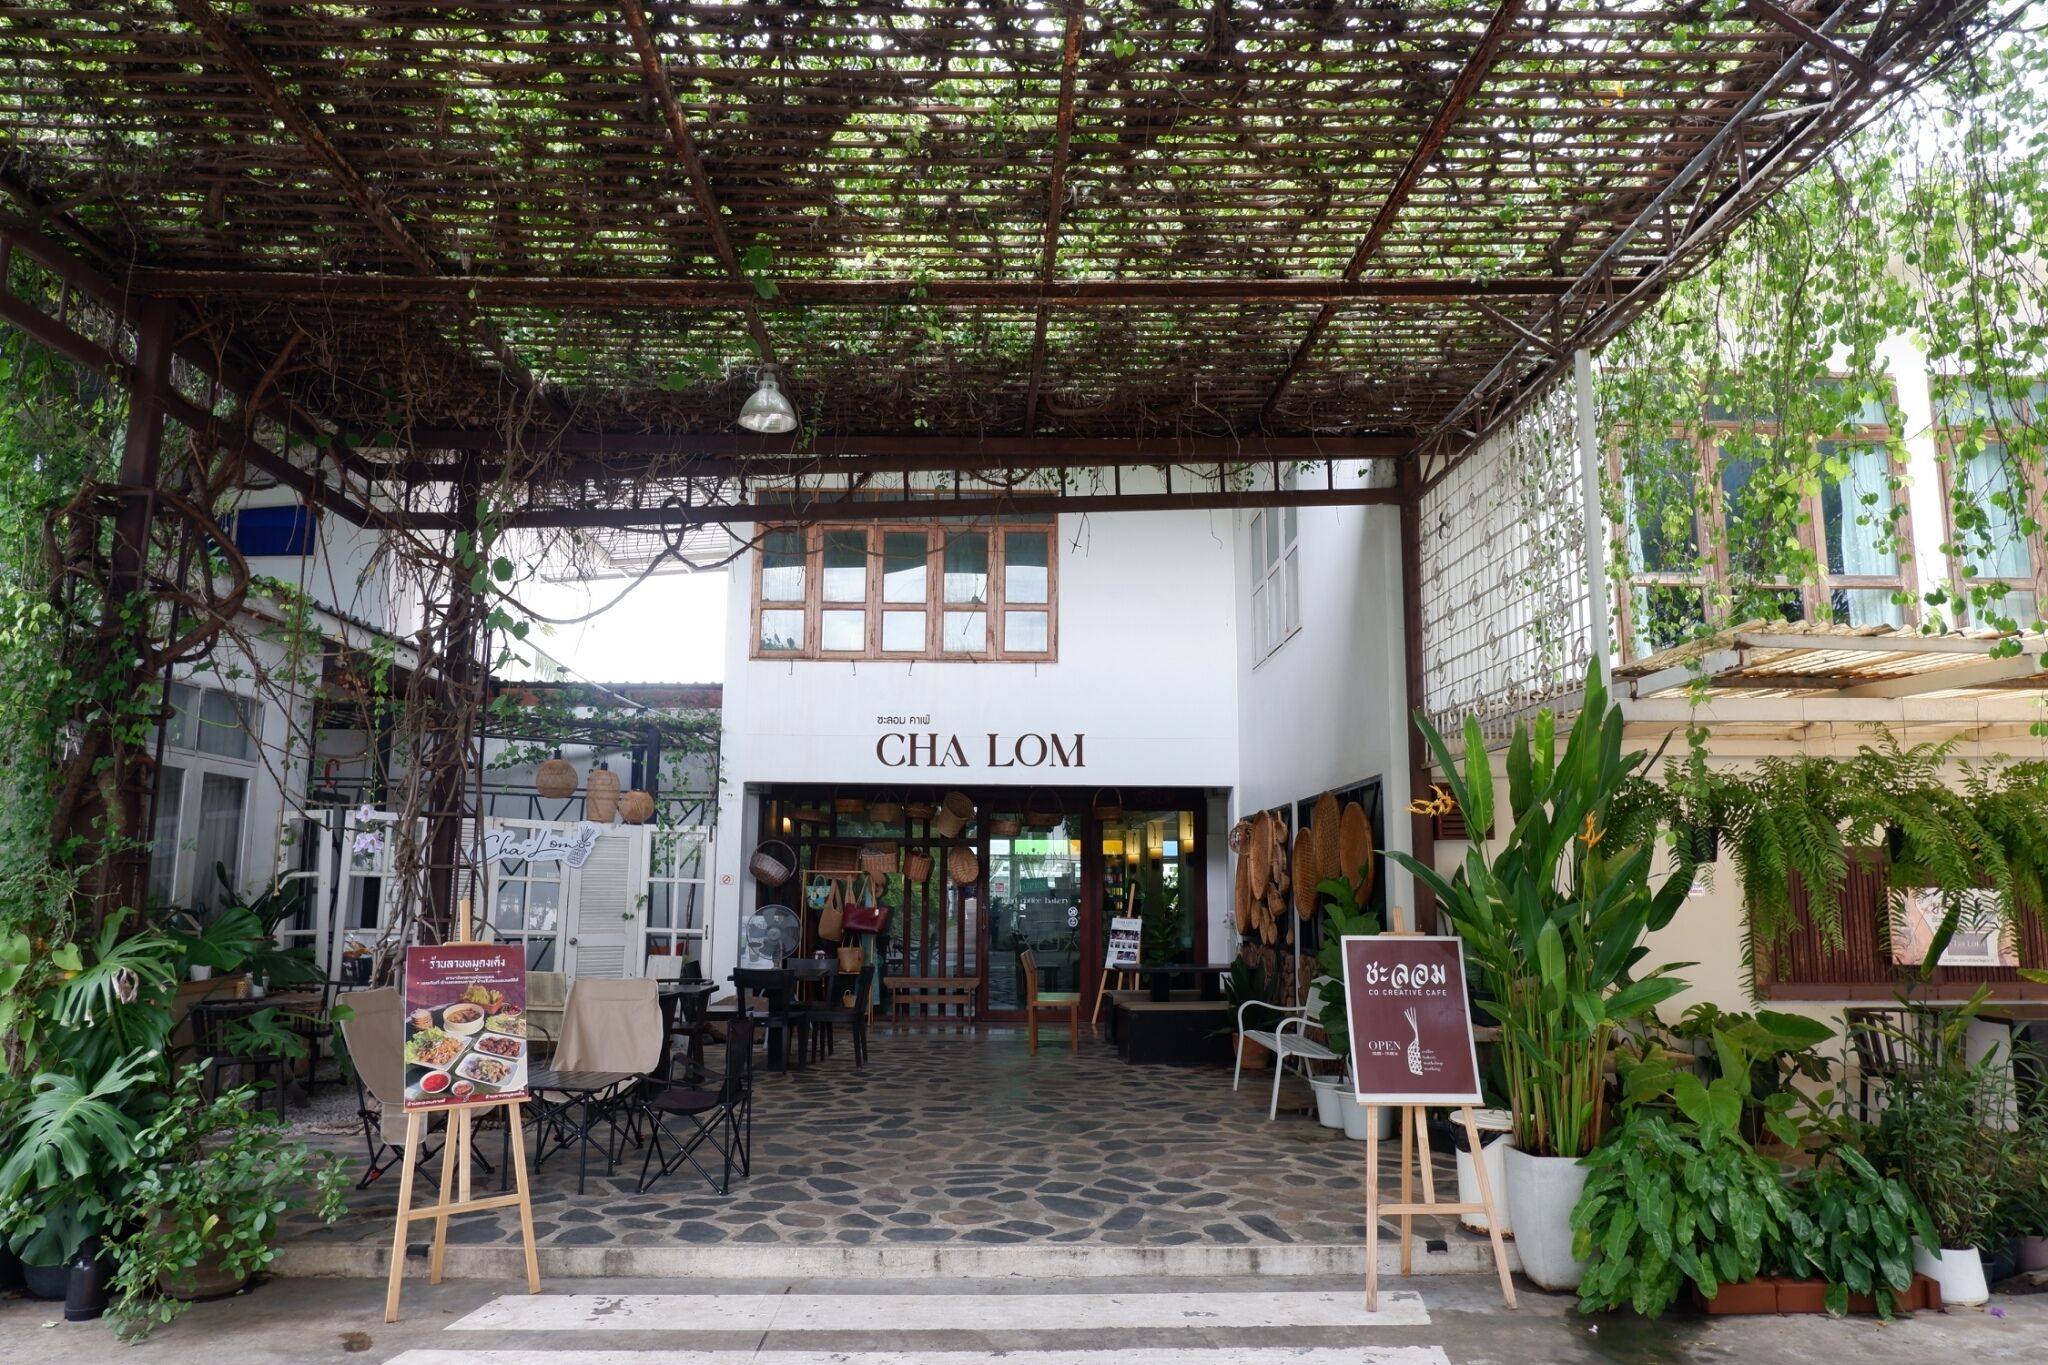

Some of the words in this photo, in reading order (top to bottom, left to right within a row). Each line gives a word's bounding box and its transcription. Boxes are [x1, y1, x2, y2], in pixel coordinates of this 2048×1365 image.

[877, 716, 906, 725] ชะลอม
[876, 733, 970, 767] CHA
[987, 733, 1086, 767] LOM
[1366, 960, 1447, 989] ชะลอม
[1368, 1040, 1401, 1051] OPEN
